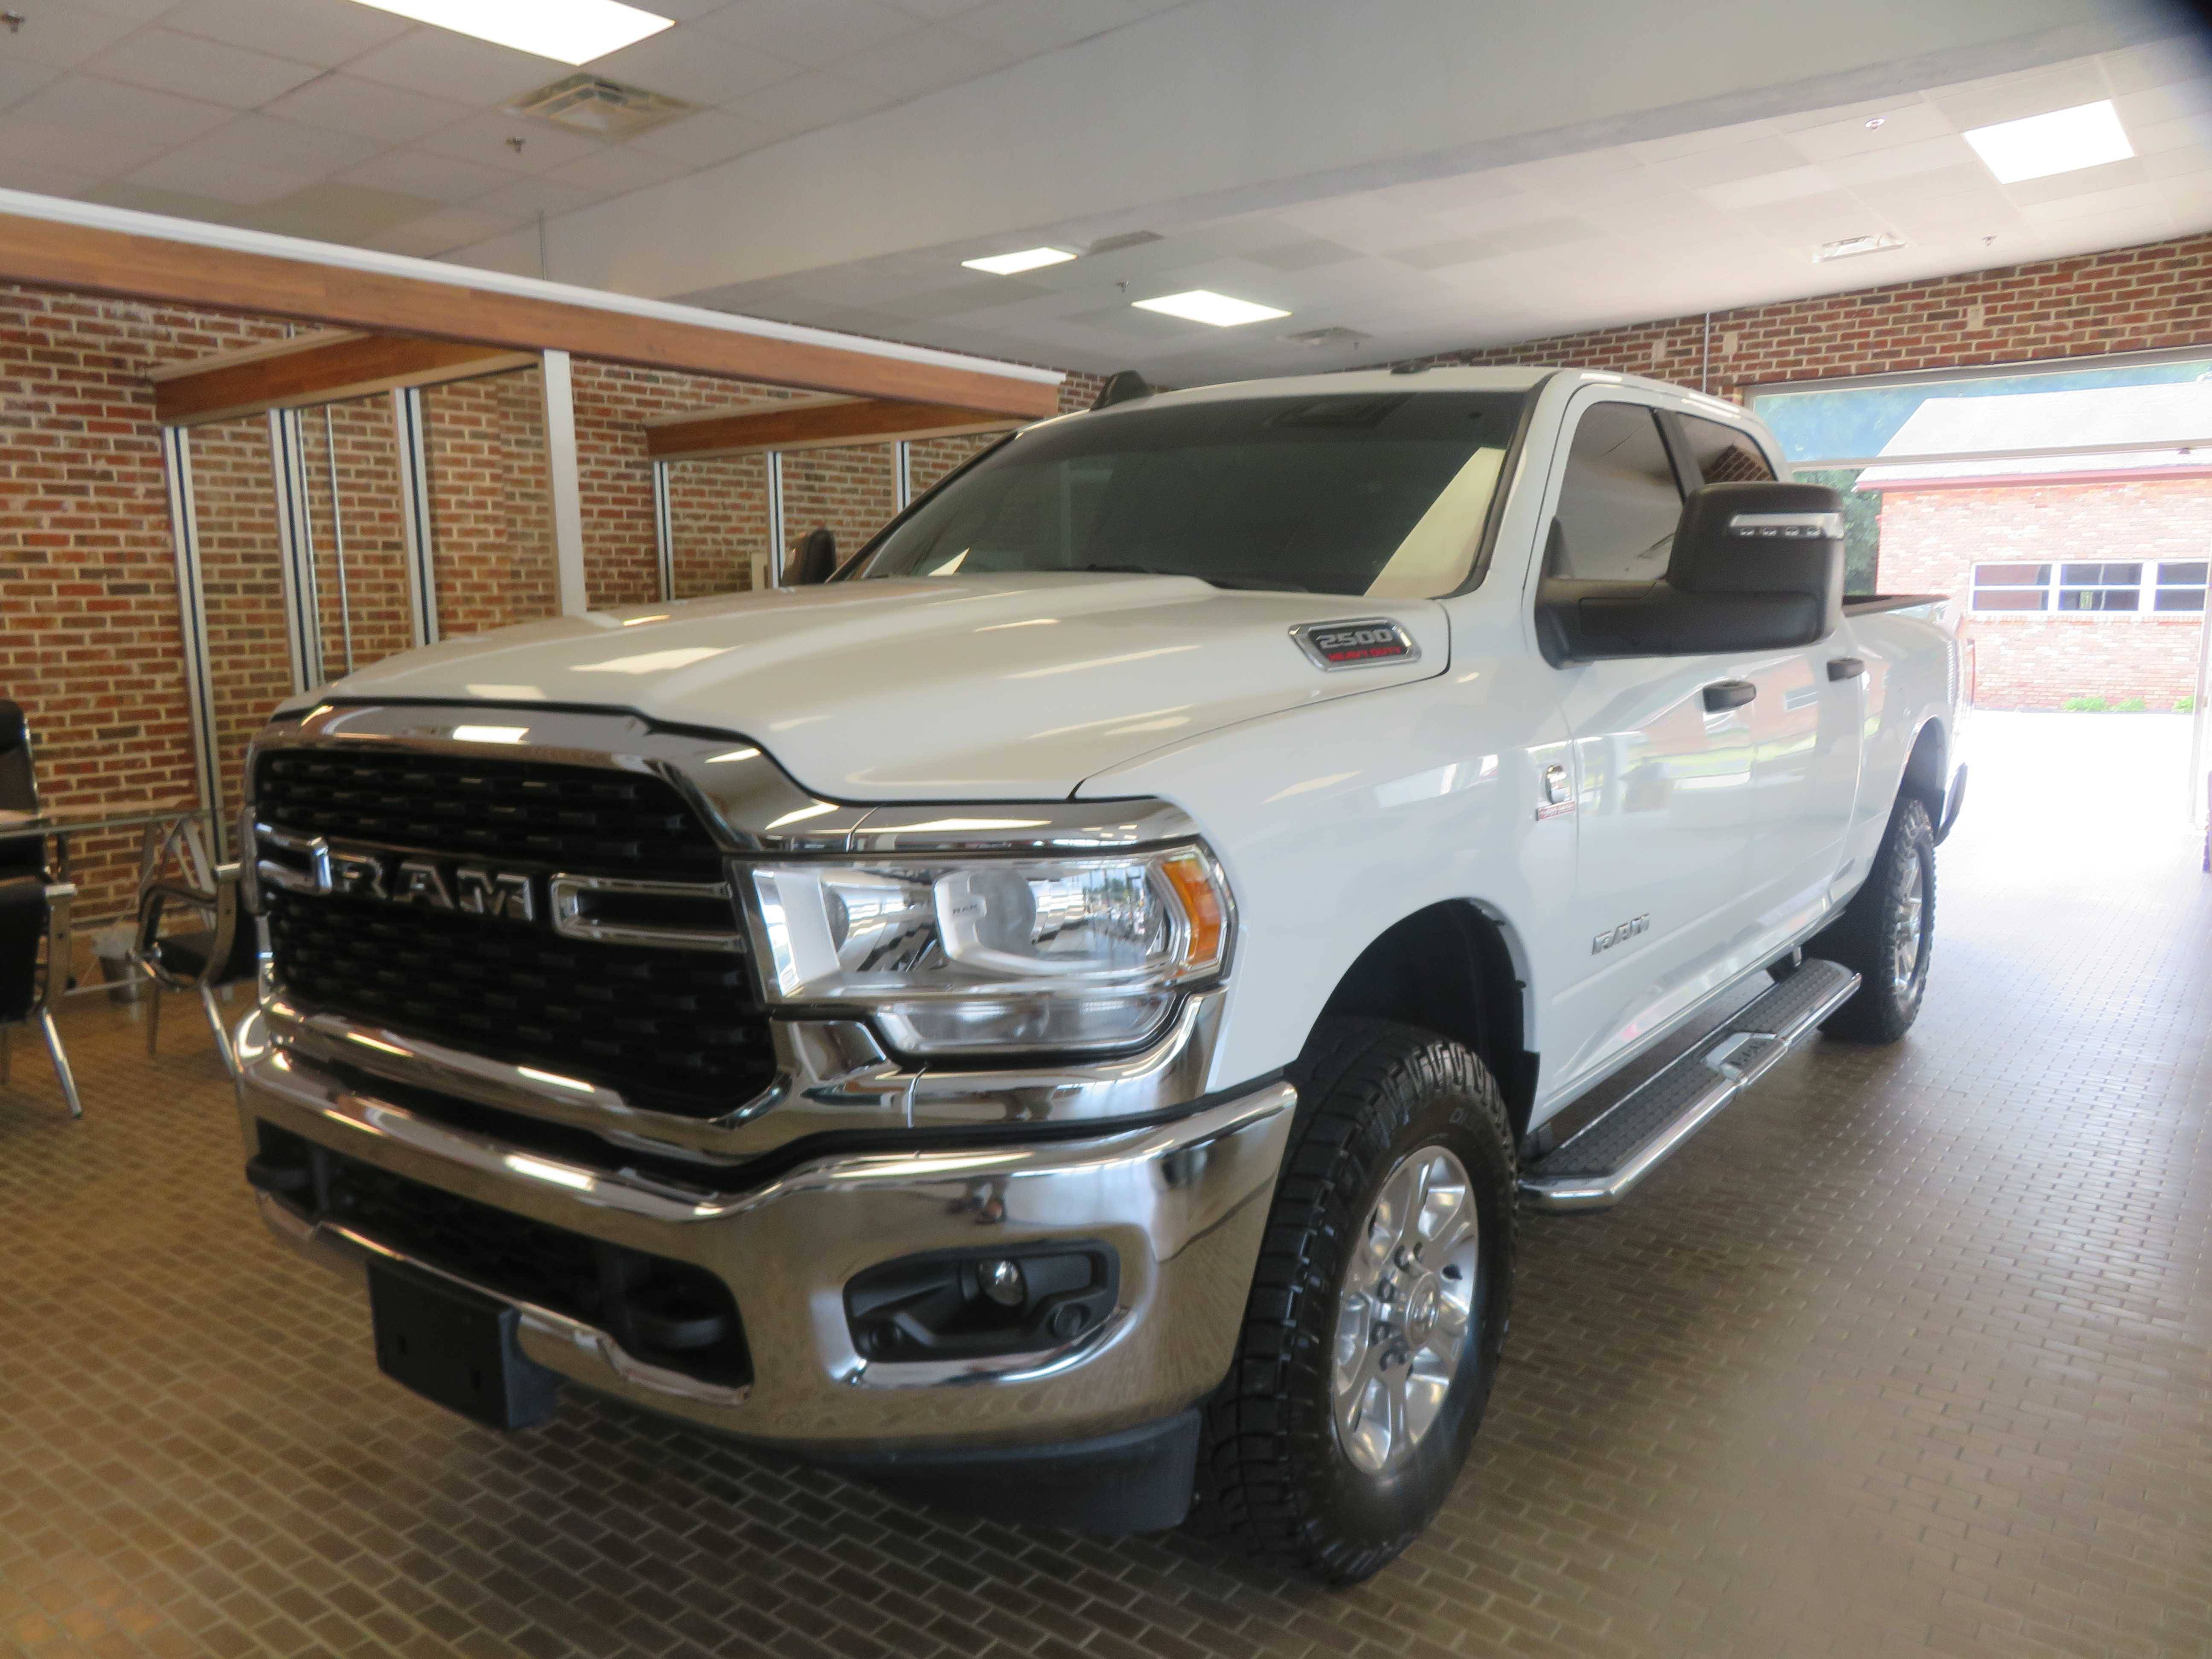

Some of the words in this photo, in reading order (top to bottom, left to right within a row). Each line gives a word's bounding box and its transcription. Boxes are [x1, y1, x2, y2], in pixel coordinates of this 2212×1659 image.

[1316, 629, 1393, 649] 2500
[1328, 650, 1367, 662] HEAVY
[1370, 646, 1401, 656] DUTY
[330, 852, 535, 922] RAM
[1592, 913, 1650, 955] RAM
